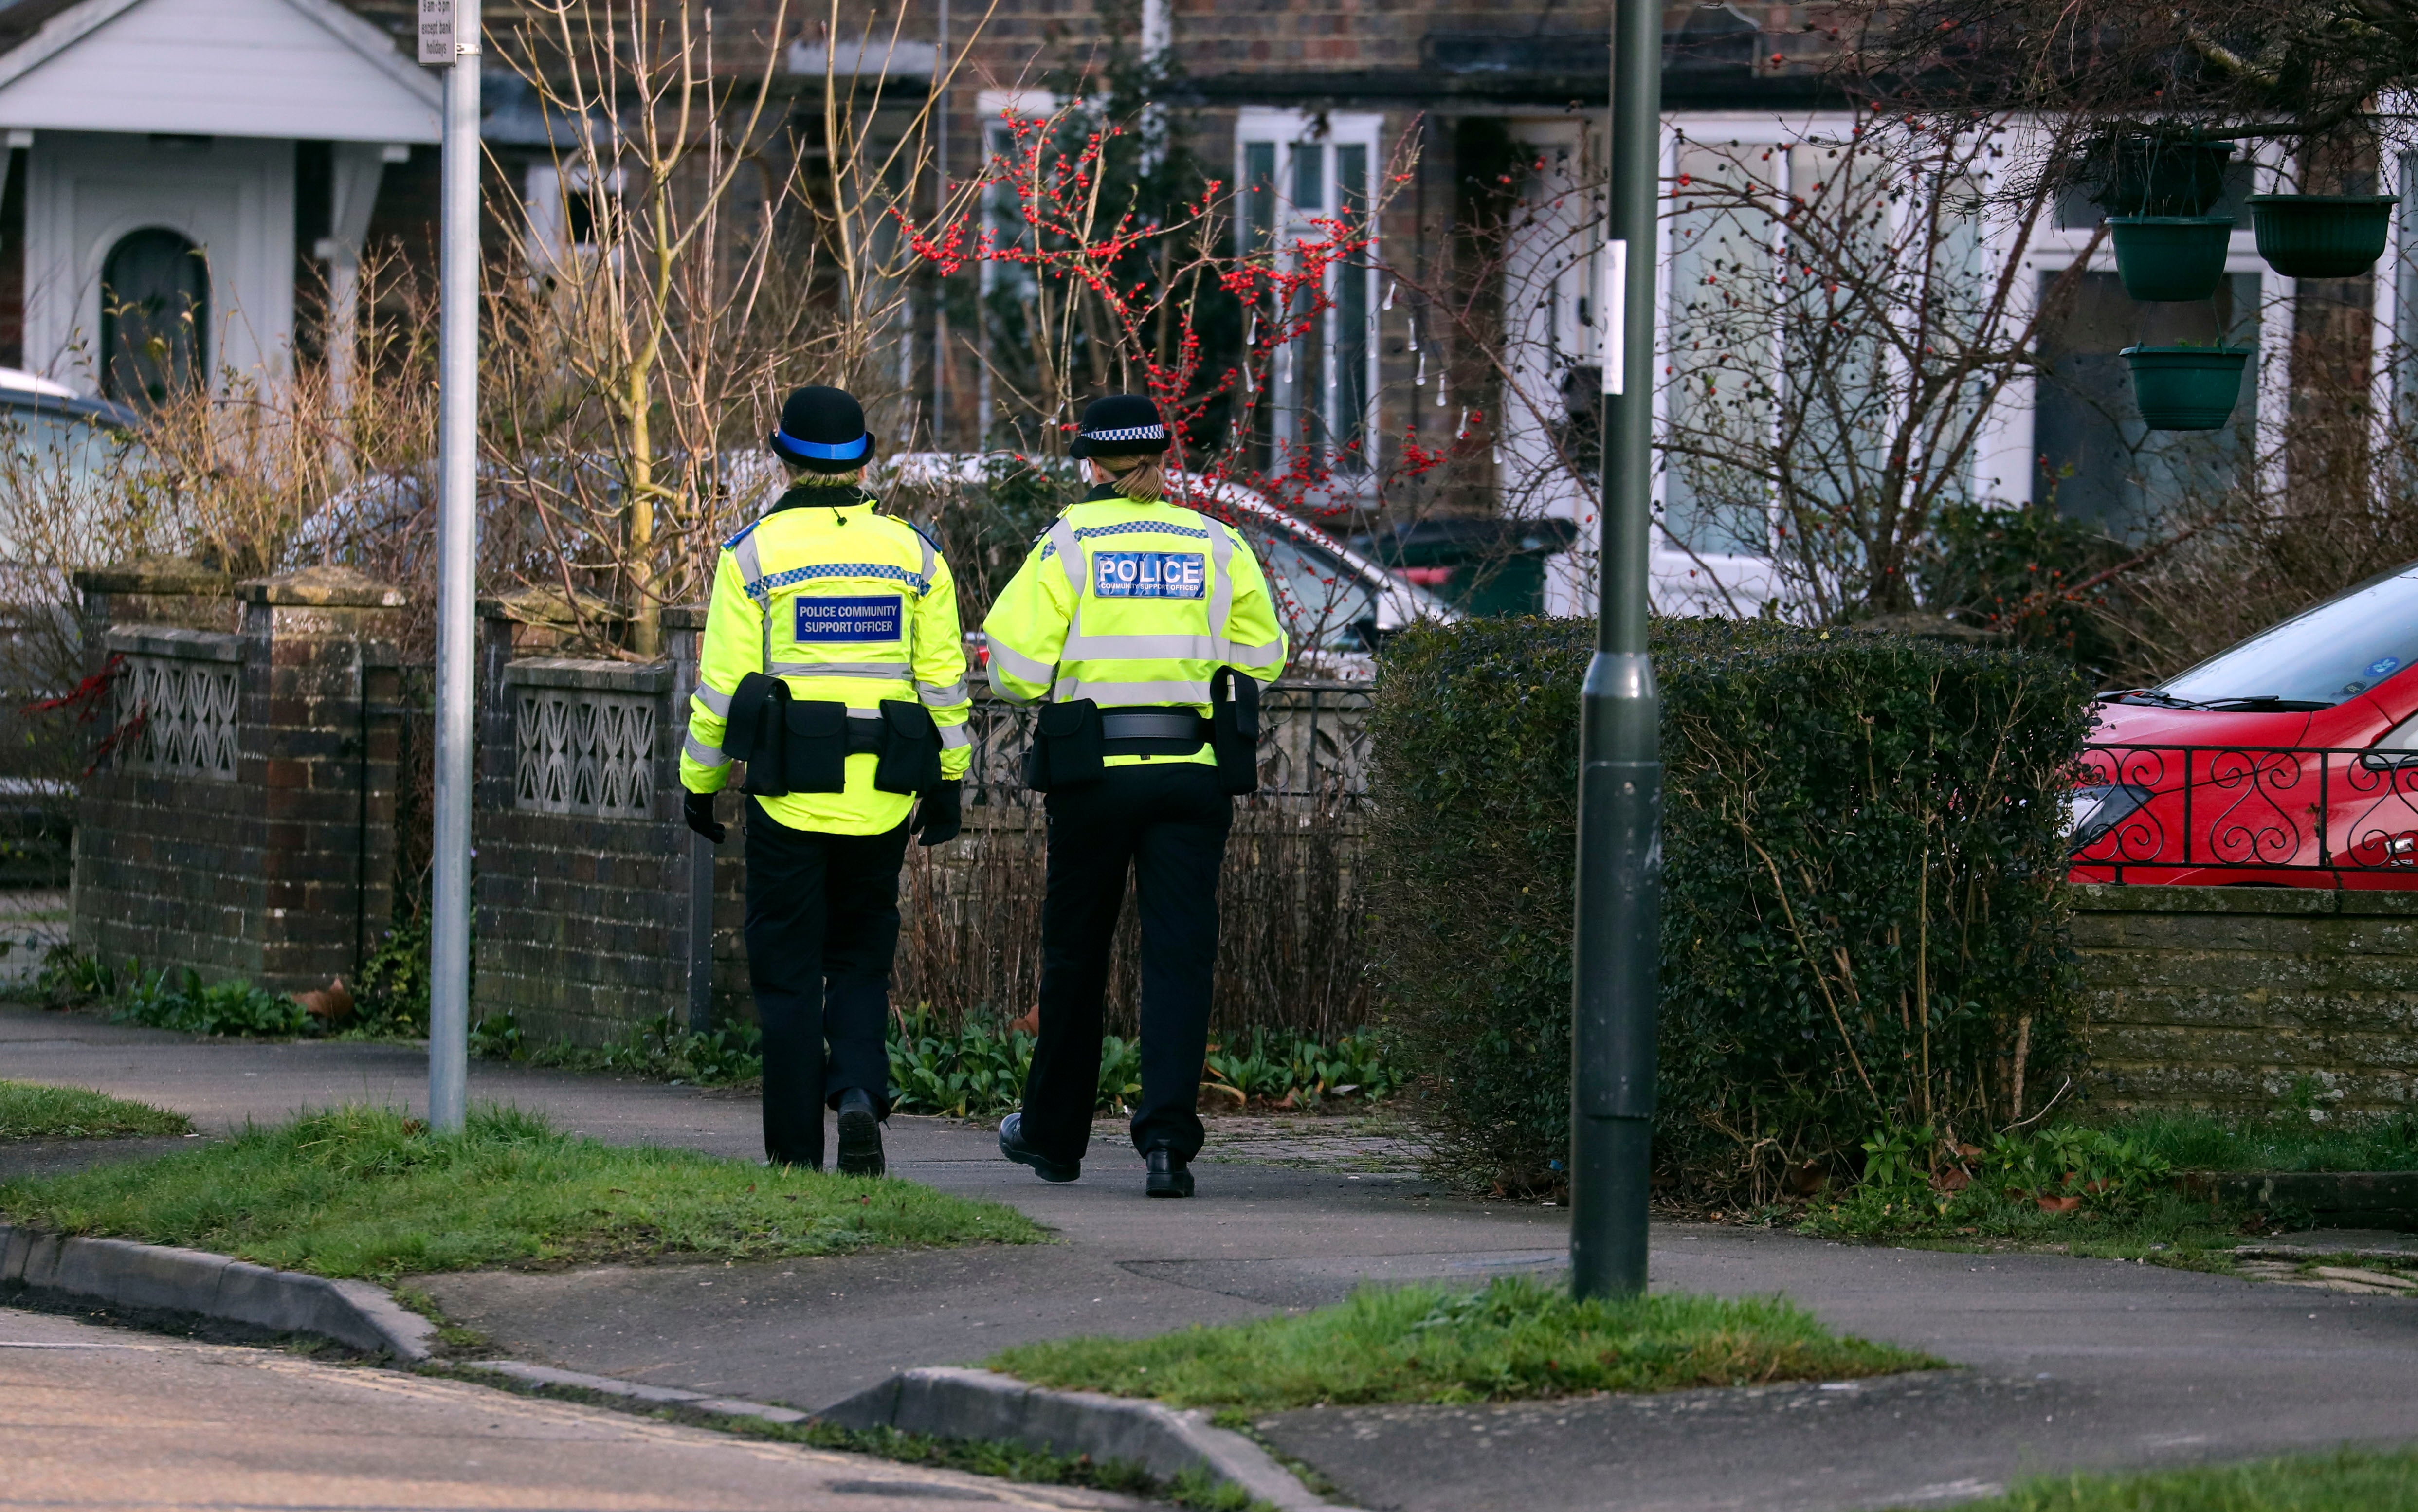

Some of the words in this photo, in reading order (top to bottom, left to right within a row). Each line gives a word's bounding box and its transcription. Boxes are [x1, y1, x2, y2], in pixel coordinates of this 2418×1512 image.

[422, 20, 438, 36] except
[439, 20, 452, 34] bank
[426, 39, 447, 57] holidays
[1099, 560, 1200, 583] POLICE
[800, 606, 836, 617] POLICE
[838, 605, 897, 617] COMMUNITY
[805, 622, 852, 633] SUPPORT
[854, 621, 893, 633] OFFICER
